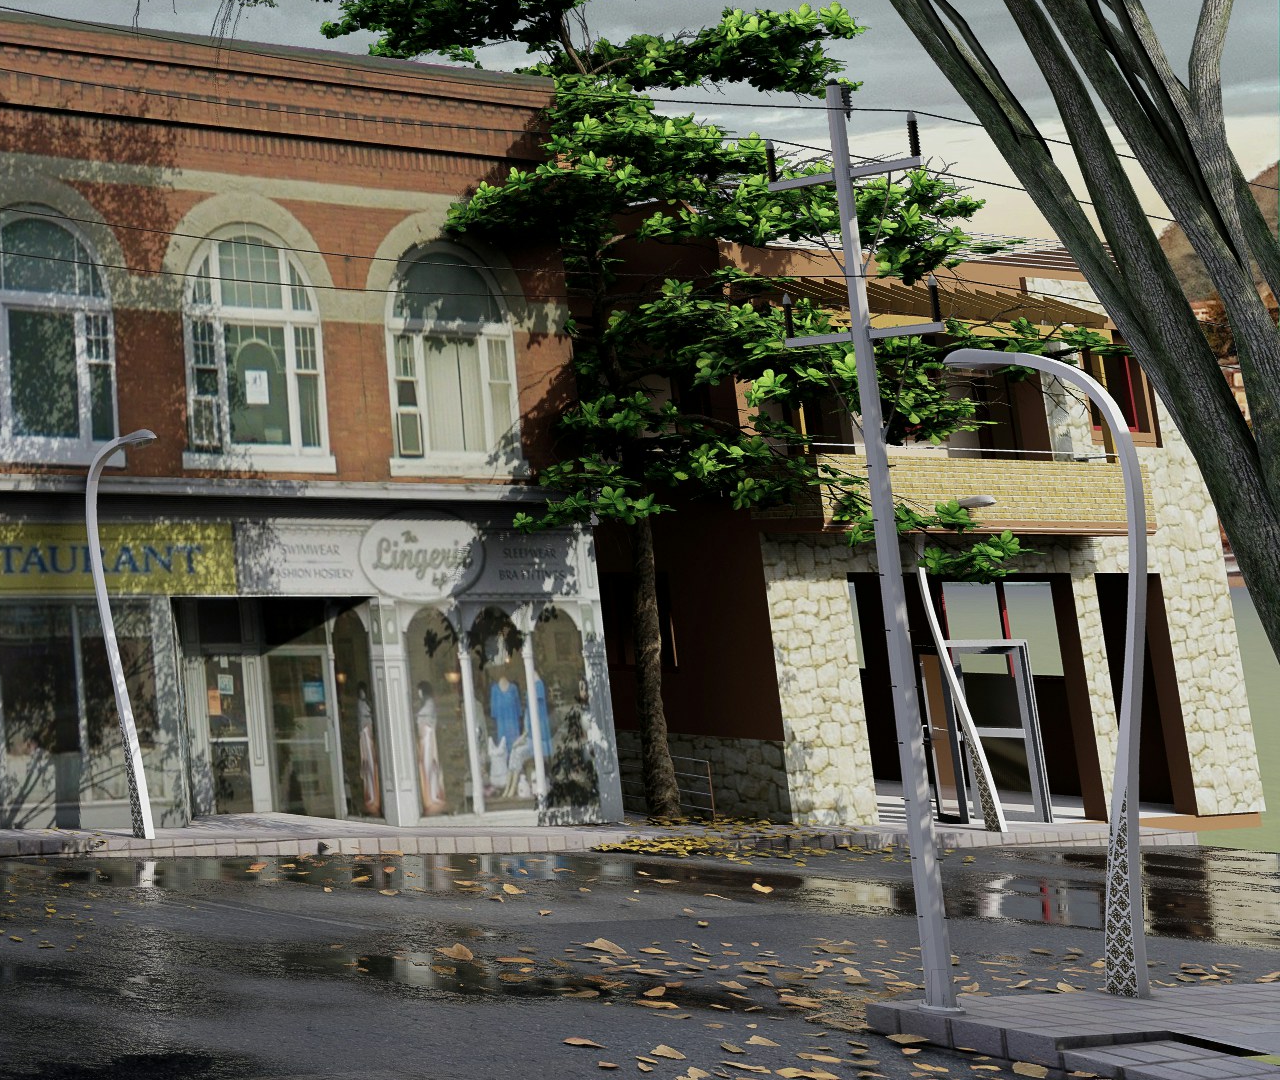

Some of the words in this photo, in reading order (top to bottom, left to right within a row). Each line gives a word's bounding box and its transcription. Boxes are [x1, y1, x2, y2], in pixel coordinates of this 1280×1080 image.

[280, 543, 342, 556] SWIMWEAR
[502, 547, 558, 560] SLEEPWEAR
[498, 569, 519, 581] BRA
